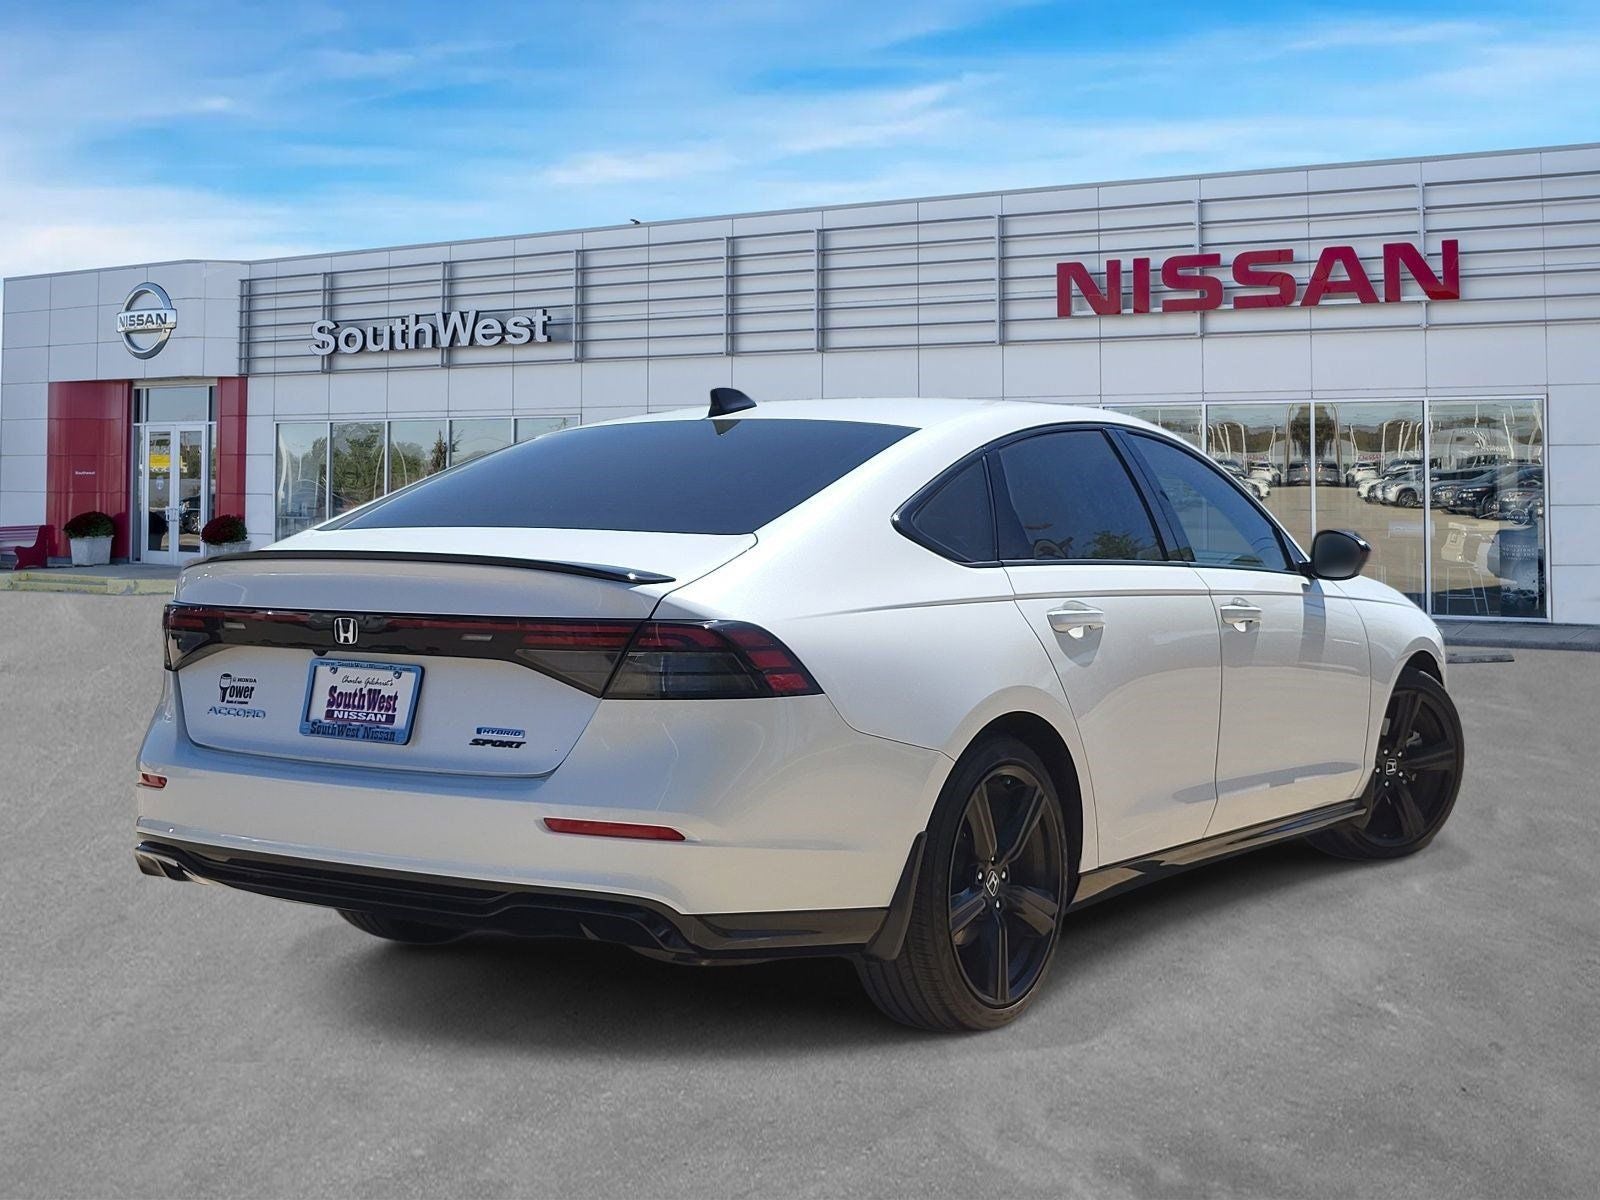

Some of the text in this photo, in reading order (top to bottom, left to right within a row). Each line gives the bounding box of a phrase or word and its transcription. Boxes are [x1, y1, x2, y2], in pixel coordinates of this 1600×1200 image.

[1056, 238, 1461, 319] NISSAN
[119, 312, 167, 328] NISSAN
[309, 308, 551, 356] SouthWest
[326, 685, 399, 713] SouthWest
[207, 706, 266, 719] ACCORD
[333, 710, 387, 722] NISSAN
[310, 721, 396, 742] SouthWest Nissan
[482, 727, 522, 737] HYBRID
[468, 738, 527, 749] SPORT
